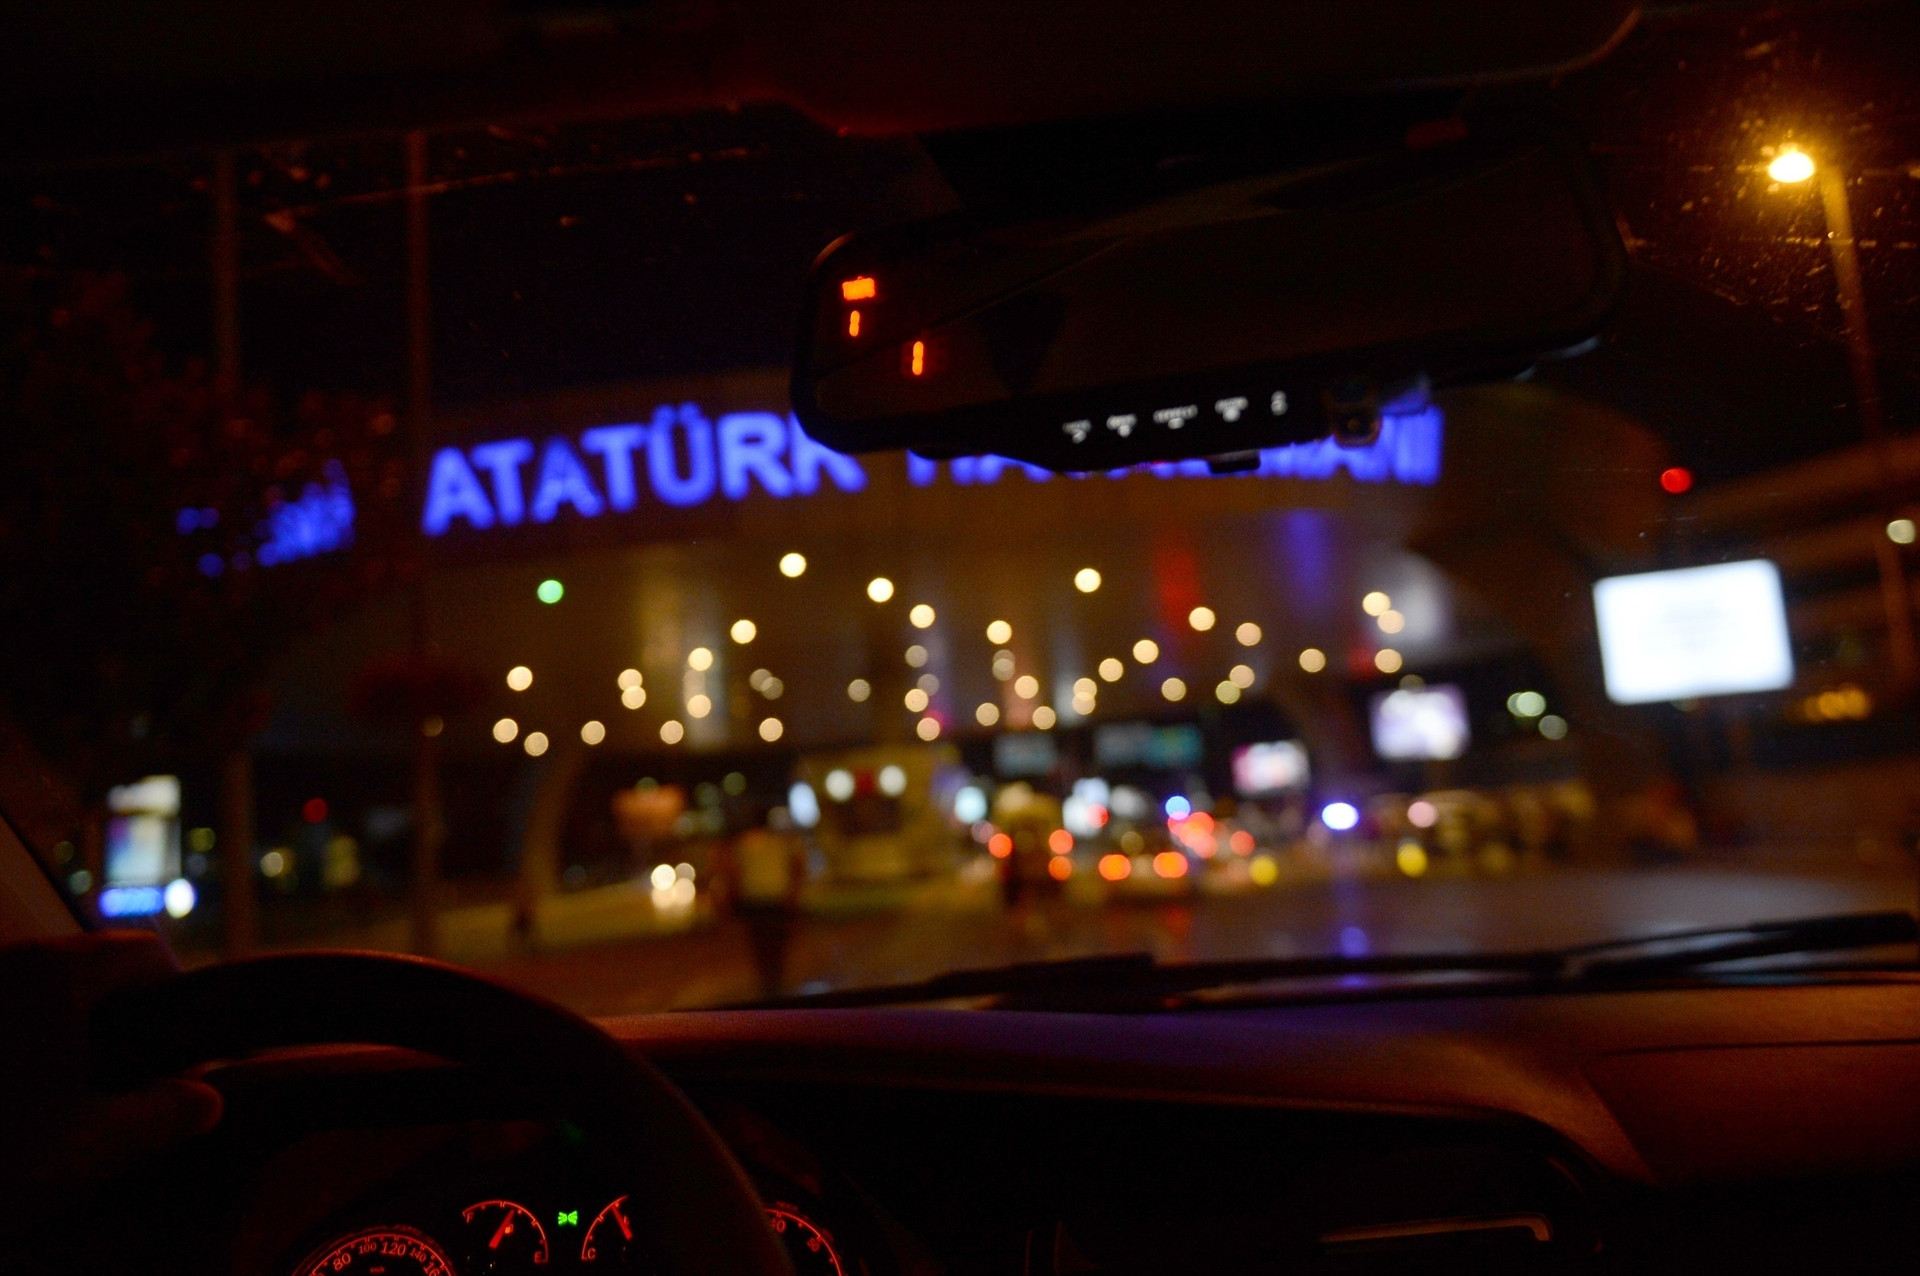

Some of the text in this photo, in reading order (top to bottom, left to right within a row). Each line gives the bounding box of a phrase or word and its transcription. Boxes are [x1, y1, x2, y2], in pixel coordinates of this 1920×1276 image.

[421, 402, 867, 536] ATATÜRK
[358, 1241, 377, 1255] 100
[379, 1240, 406, 1257] 120
[408, 1247, 427, 1263] 140
[332, 1252, 352, 1271] 80
[422, 1261, 441, 1276] 16
